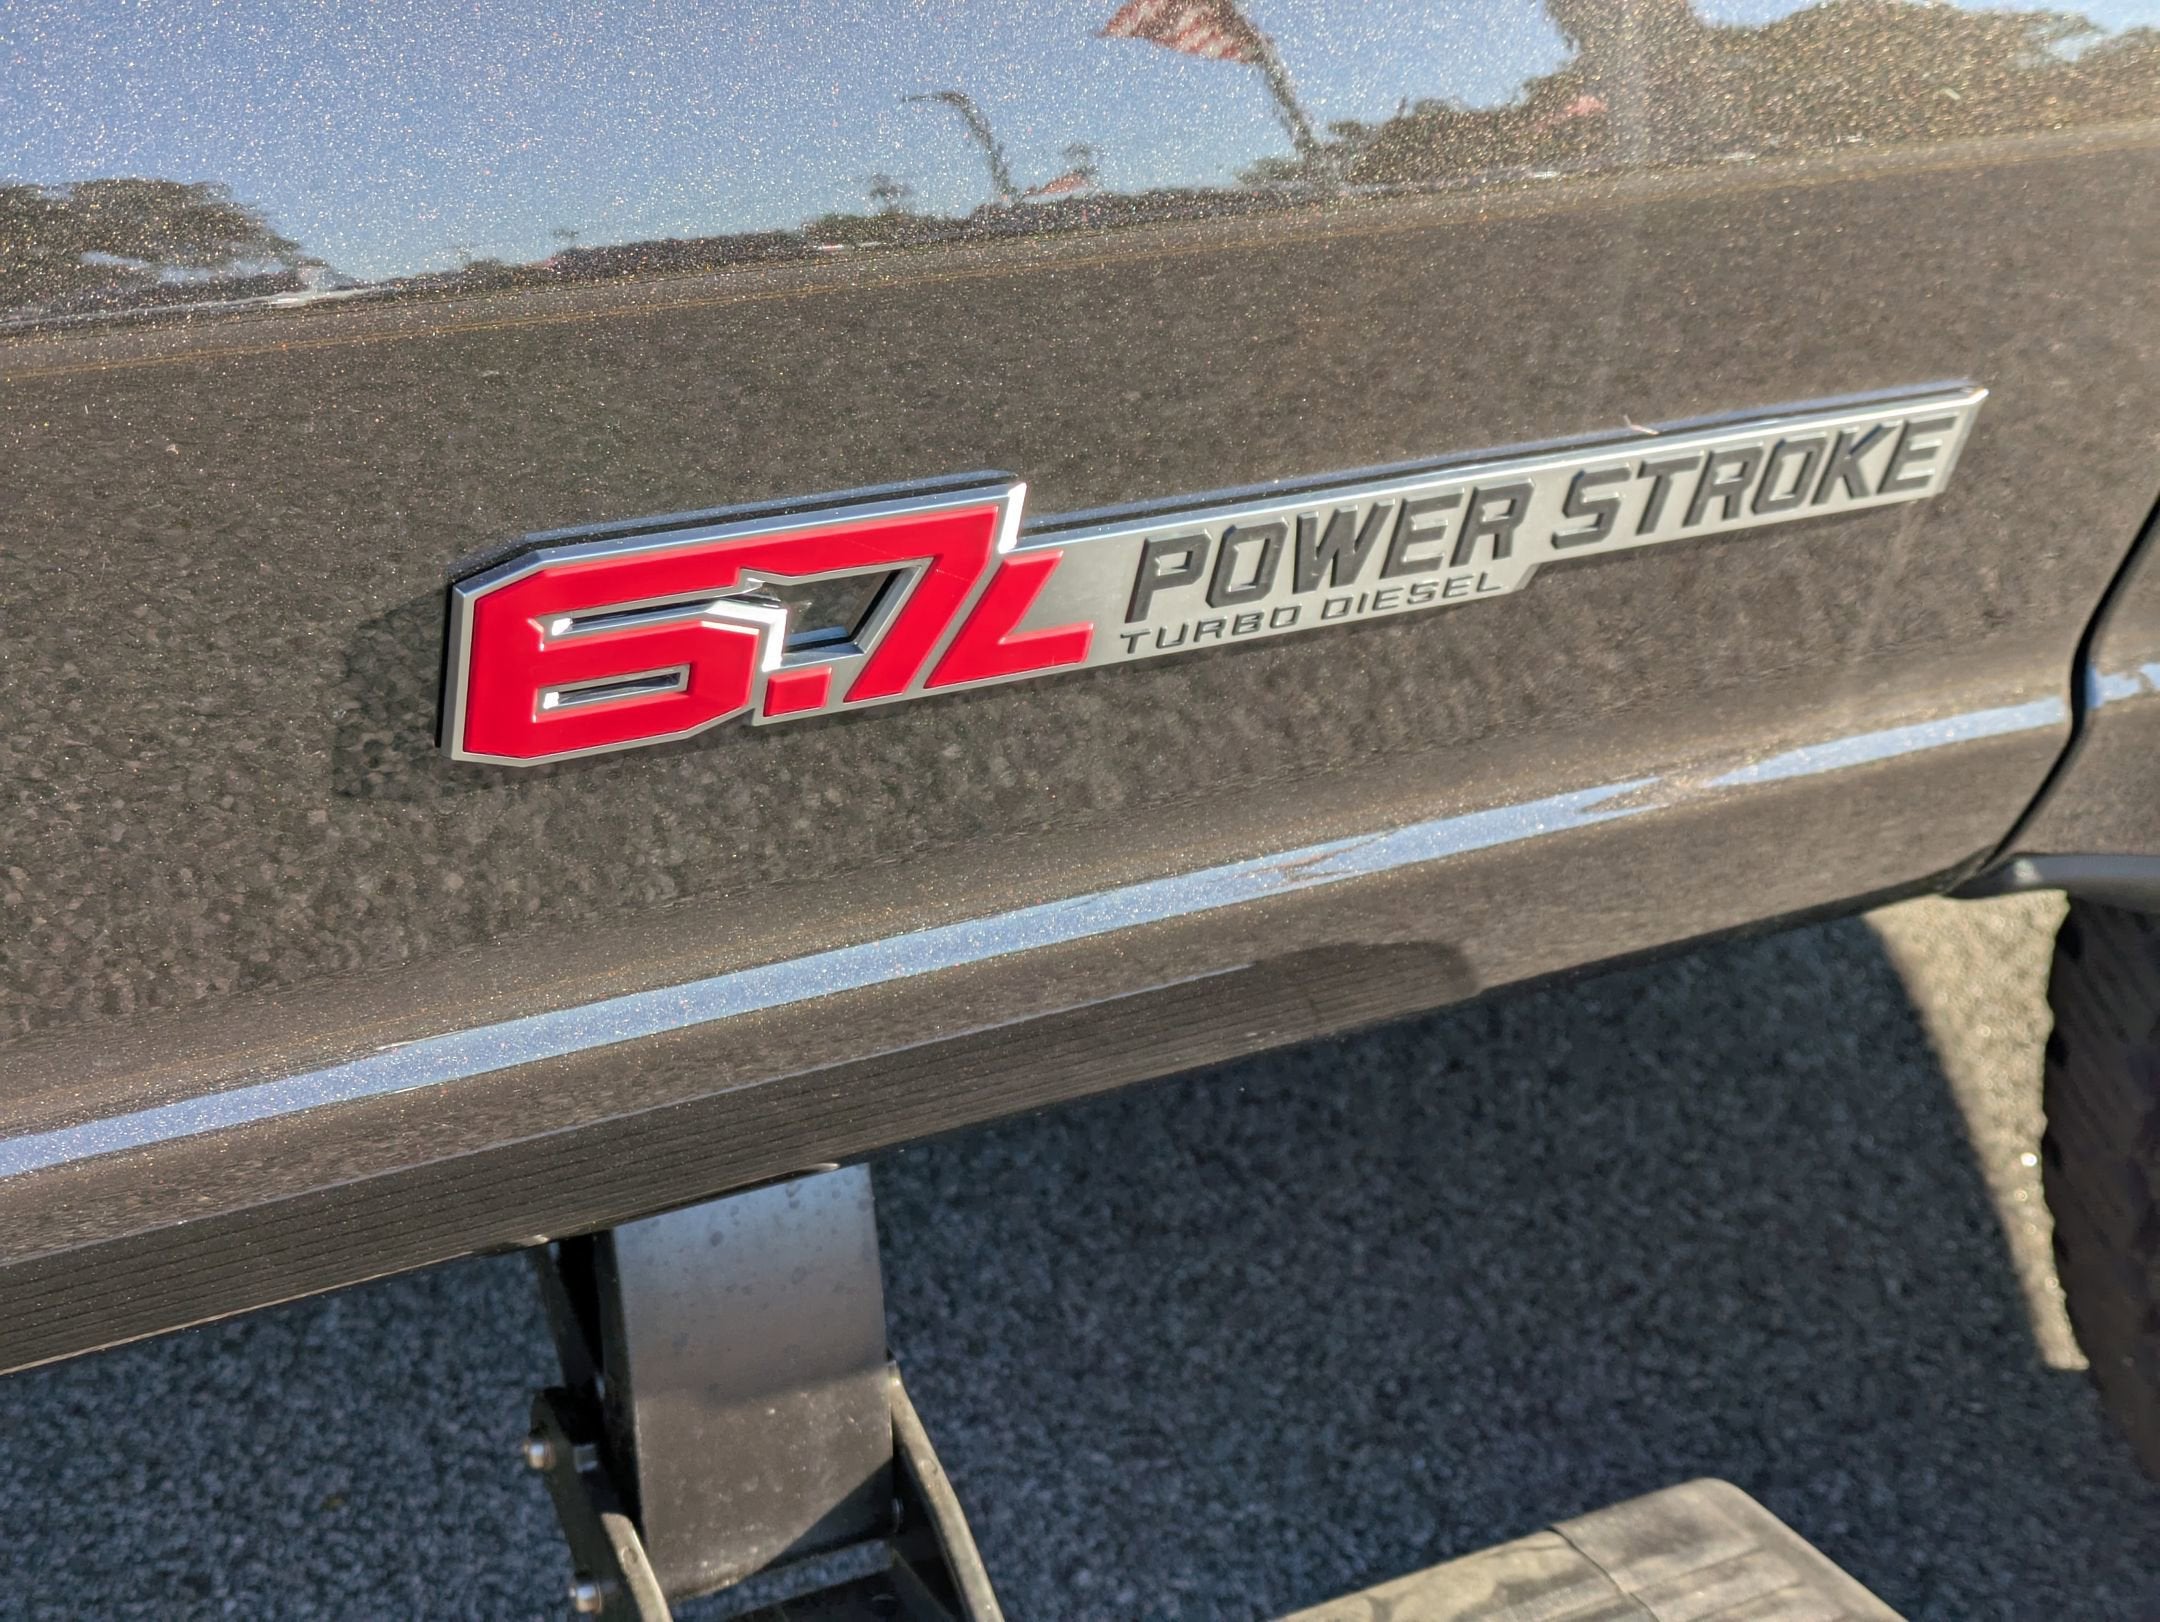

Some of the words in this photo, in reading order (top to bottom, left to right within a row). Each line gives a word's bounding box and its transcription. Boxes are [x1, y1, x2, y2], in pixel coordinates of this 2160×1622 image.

[462, 505, 1095, 759] 6.7L
[1124, 478, 1535, 624] POWER
[1550, 414, 1958, 549] STROKE
[1119, 602, 1303, 655] TURBO
[1320, 571, 1503, 621] DIESEL
